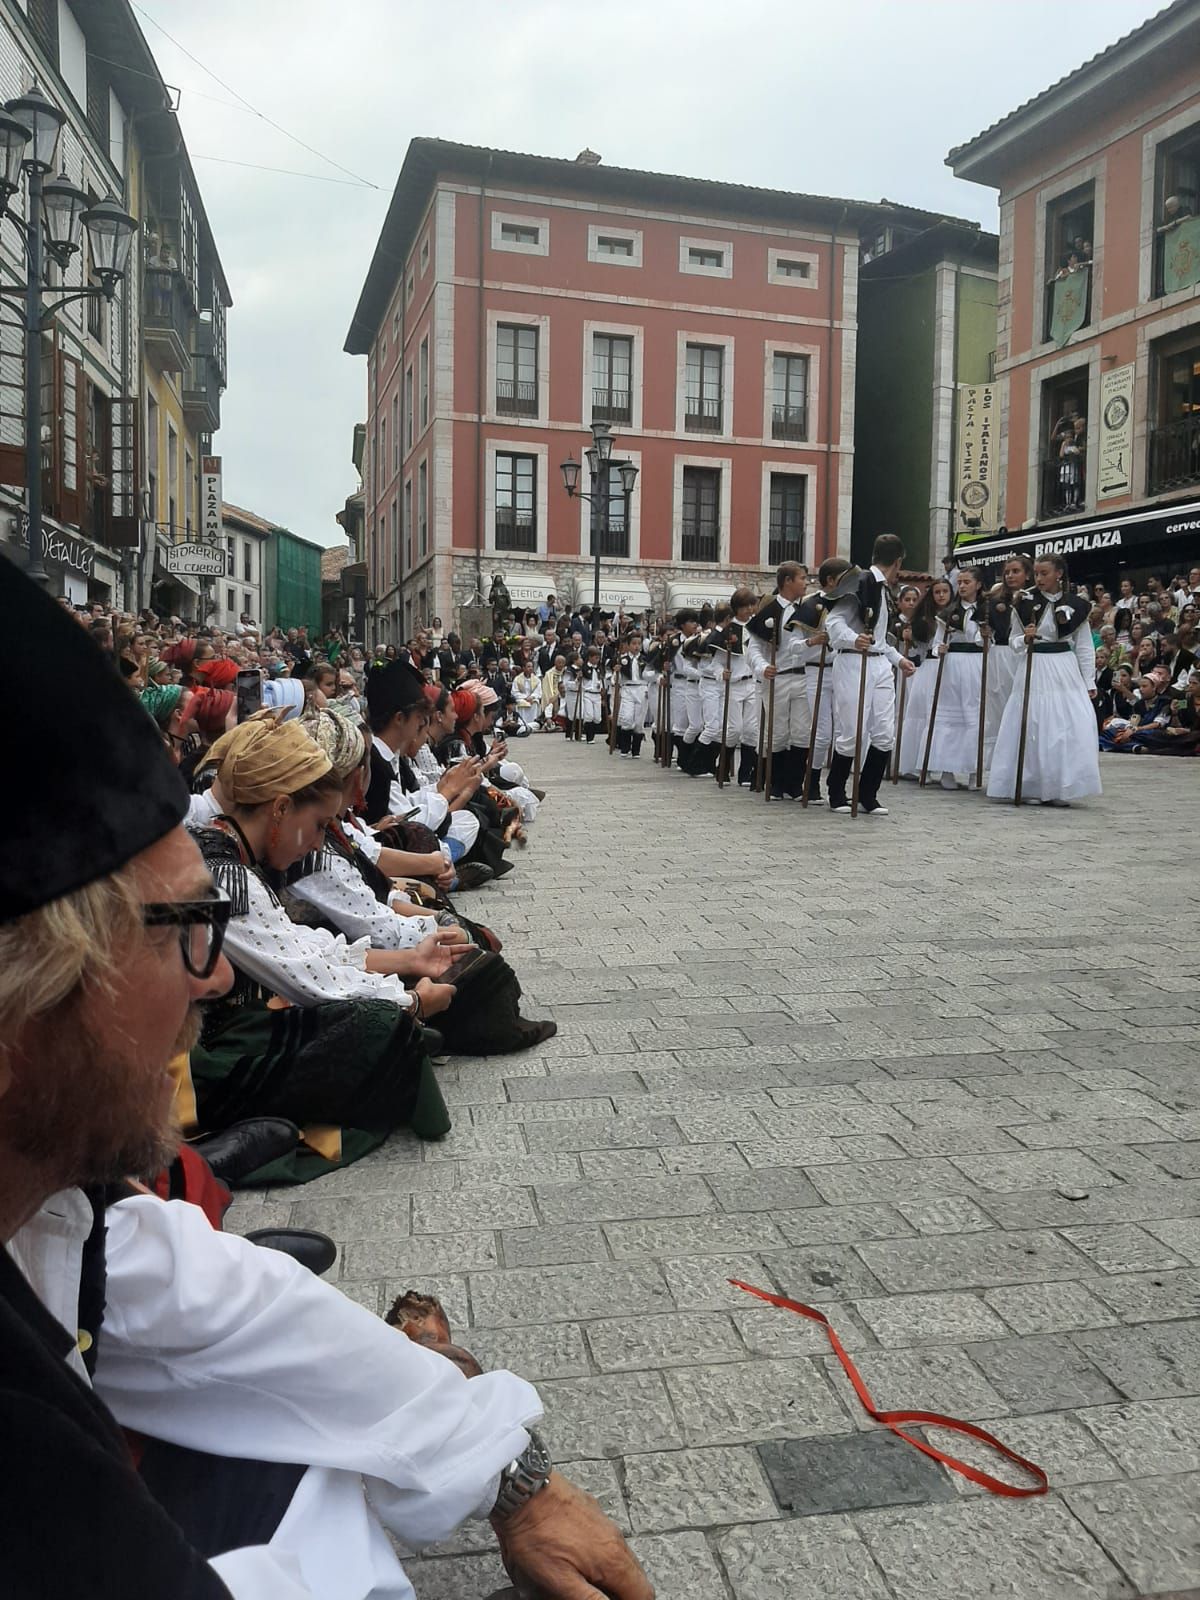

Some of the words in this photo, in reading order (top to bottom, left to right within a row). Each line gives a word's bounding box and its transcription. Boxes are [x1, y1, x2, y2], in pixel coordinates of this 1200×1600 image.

[966, 389, 976, 427] PASTA
[983, 388, 992, 409] LOS
[963, 442, 973, 480] PIZZA
[979, 417, 991, 481] ITALIANOS
[207, 477, 217, 517] PLAZA
[1035, 530, 1122, 558] BOCAPLAZA
[511, 589, 544, 599] ETETICA
